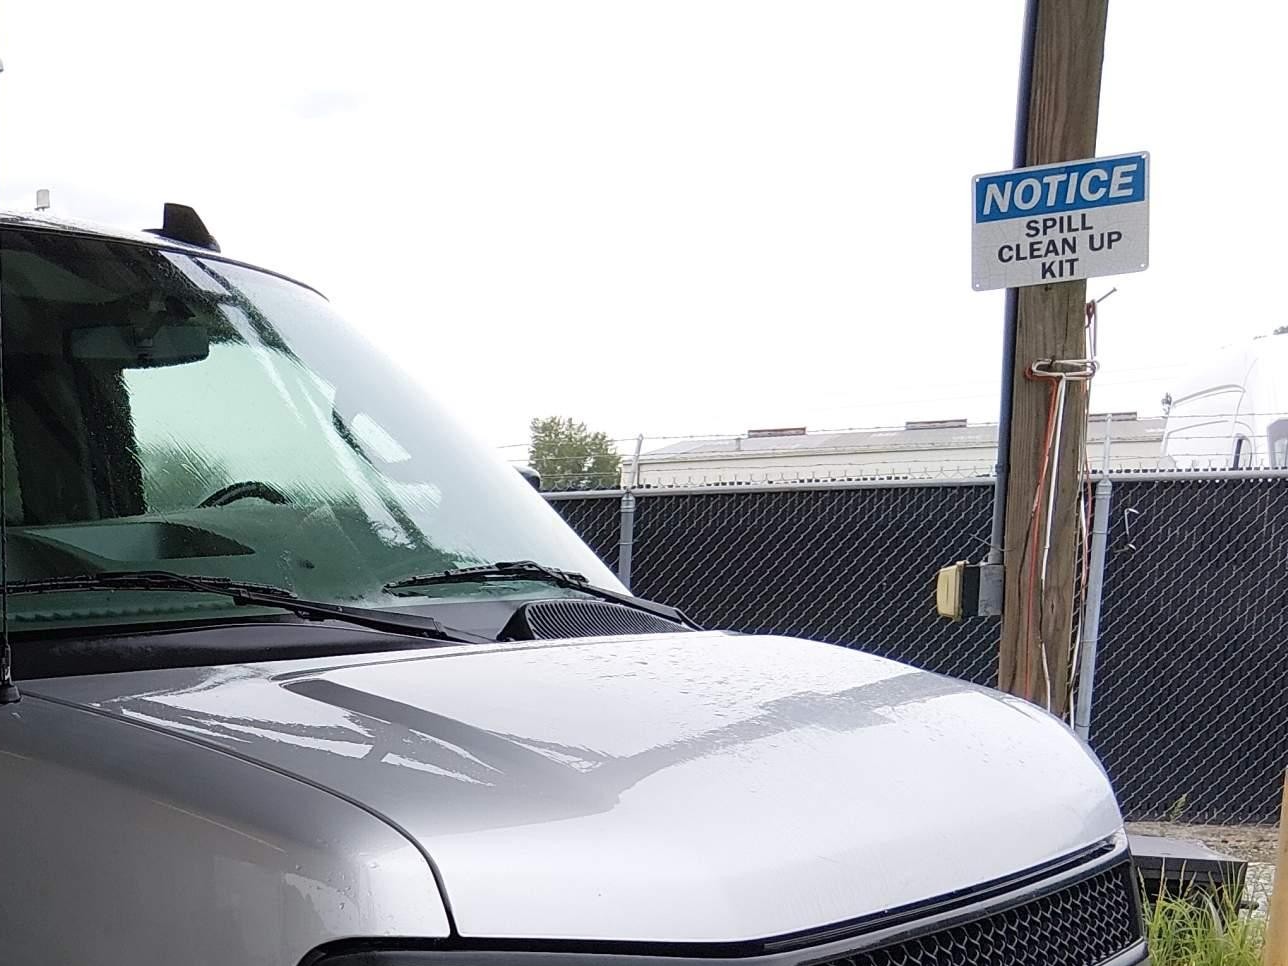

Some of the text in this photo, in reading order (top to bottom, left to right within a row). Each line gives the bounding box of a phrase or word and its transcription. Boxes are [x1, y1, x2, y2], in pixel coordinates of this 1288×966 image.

[982, 163, 1138, 215] NOTICE
[1025, 213, 1093, 237] SPILL
[998, 231, 1122, 263] CLEAN UP
[1041, 258, 1079, 279] KIT
